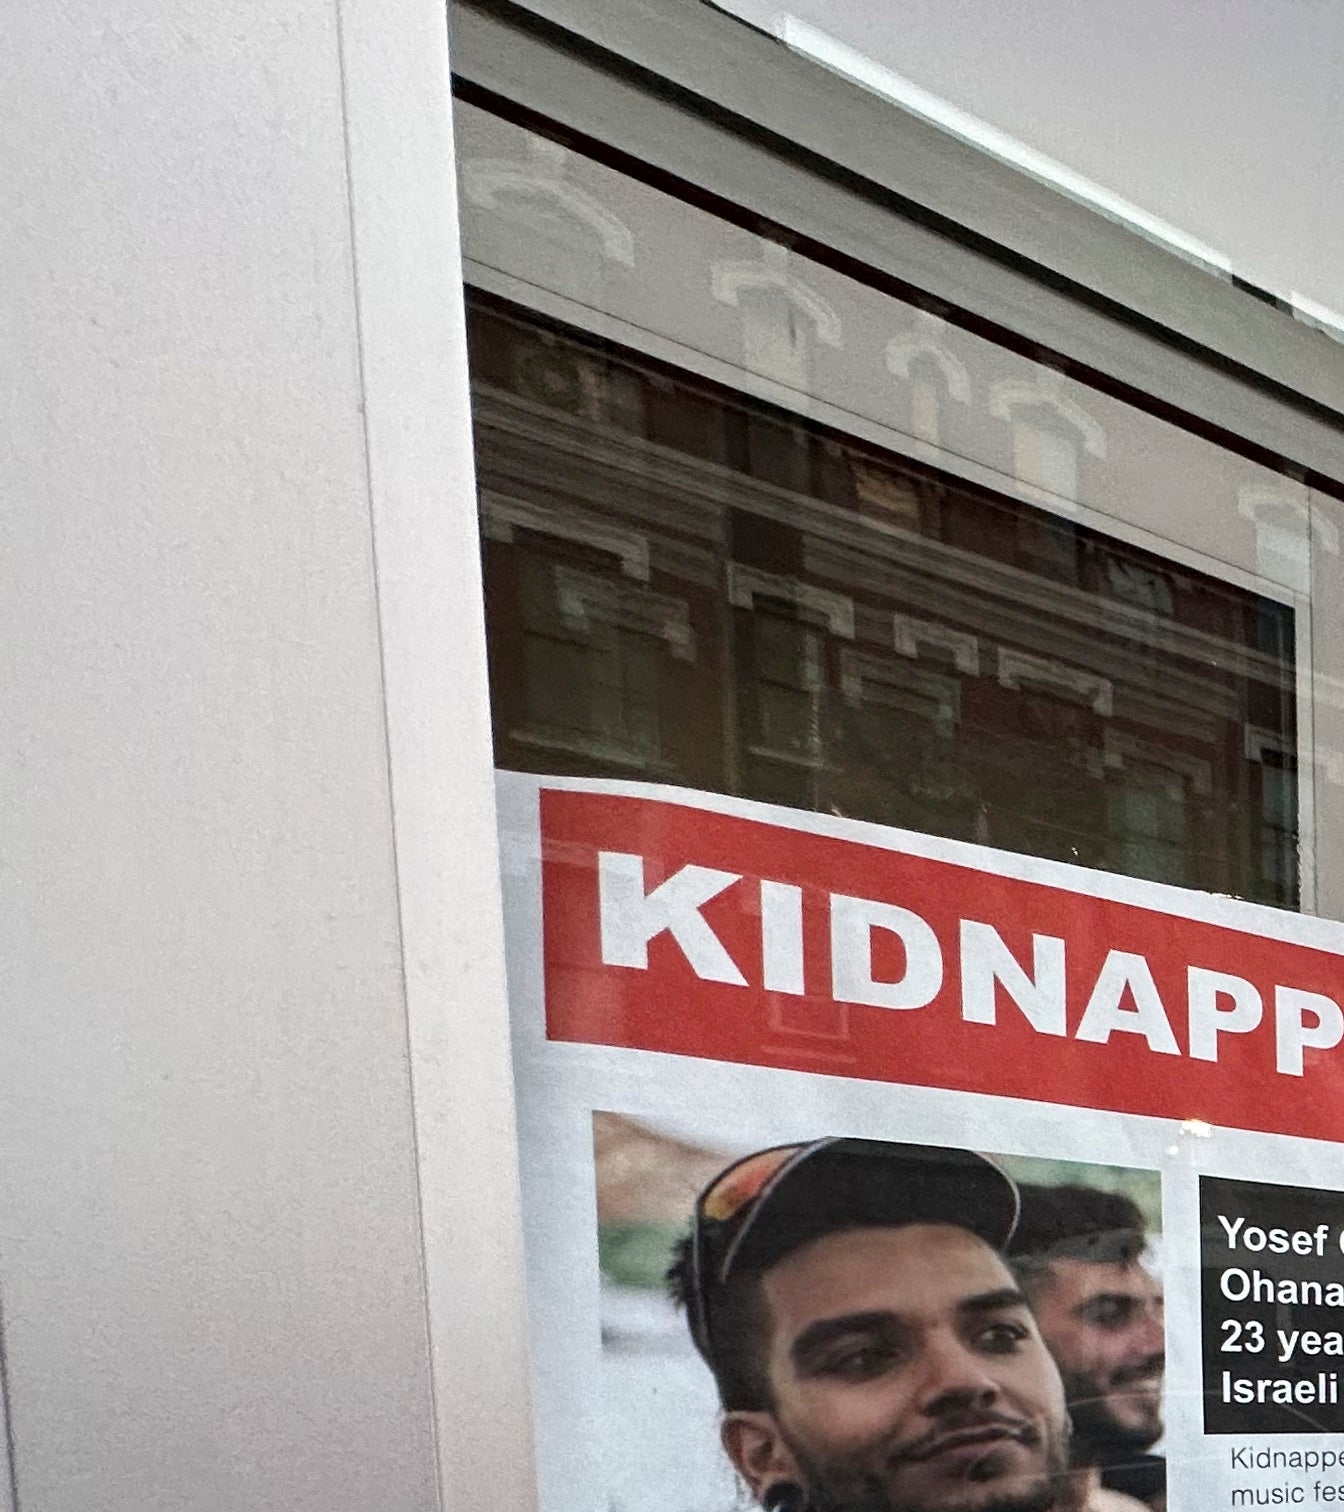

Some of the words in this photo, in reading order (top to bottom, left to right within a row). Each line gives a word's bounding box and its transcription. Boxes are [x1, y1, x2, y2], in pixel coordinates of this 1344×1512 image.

[1218, 1215, 1329, 1256] Yosef
[1220, 1319, 1265, 1353] 23
[1222, 1371, 1338, 1404] Israeli
[1232, 1482, 1304, 1506] music
